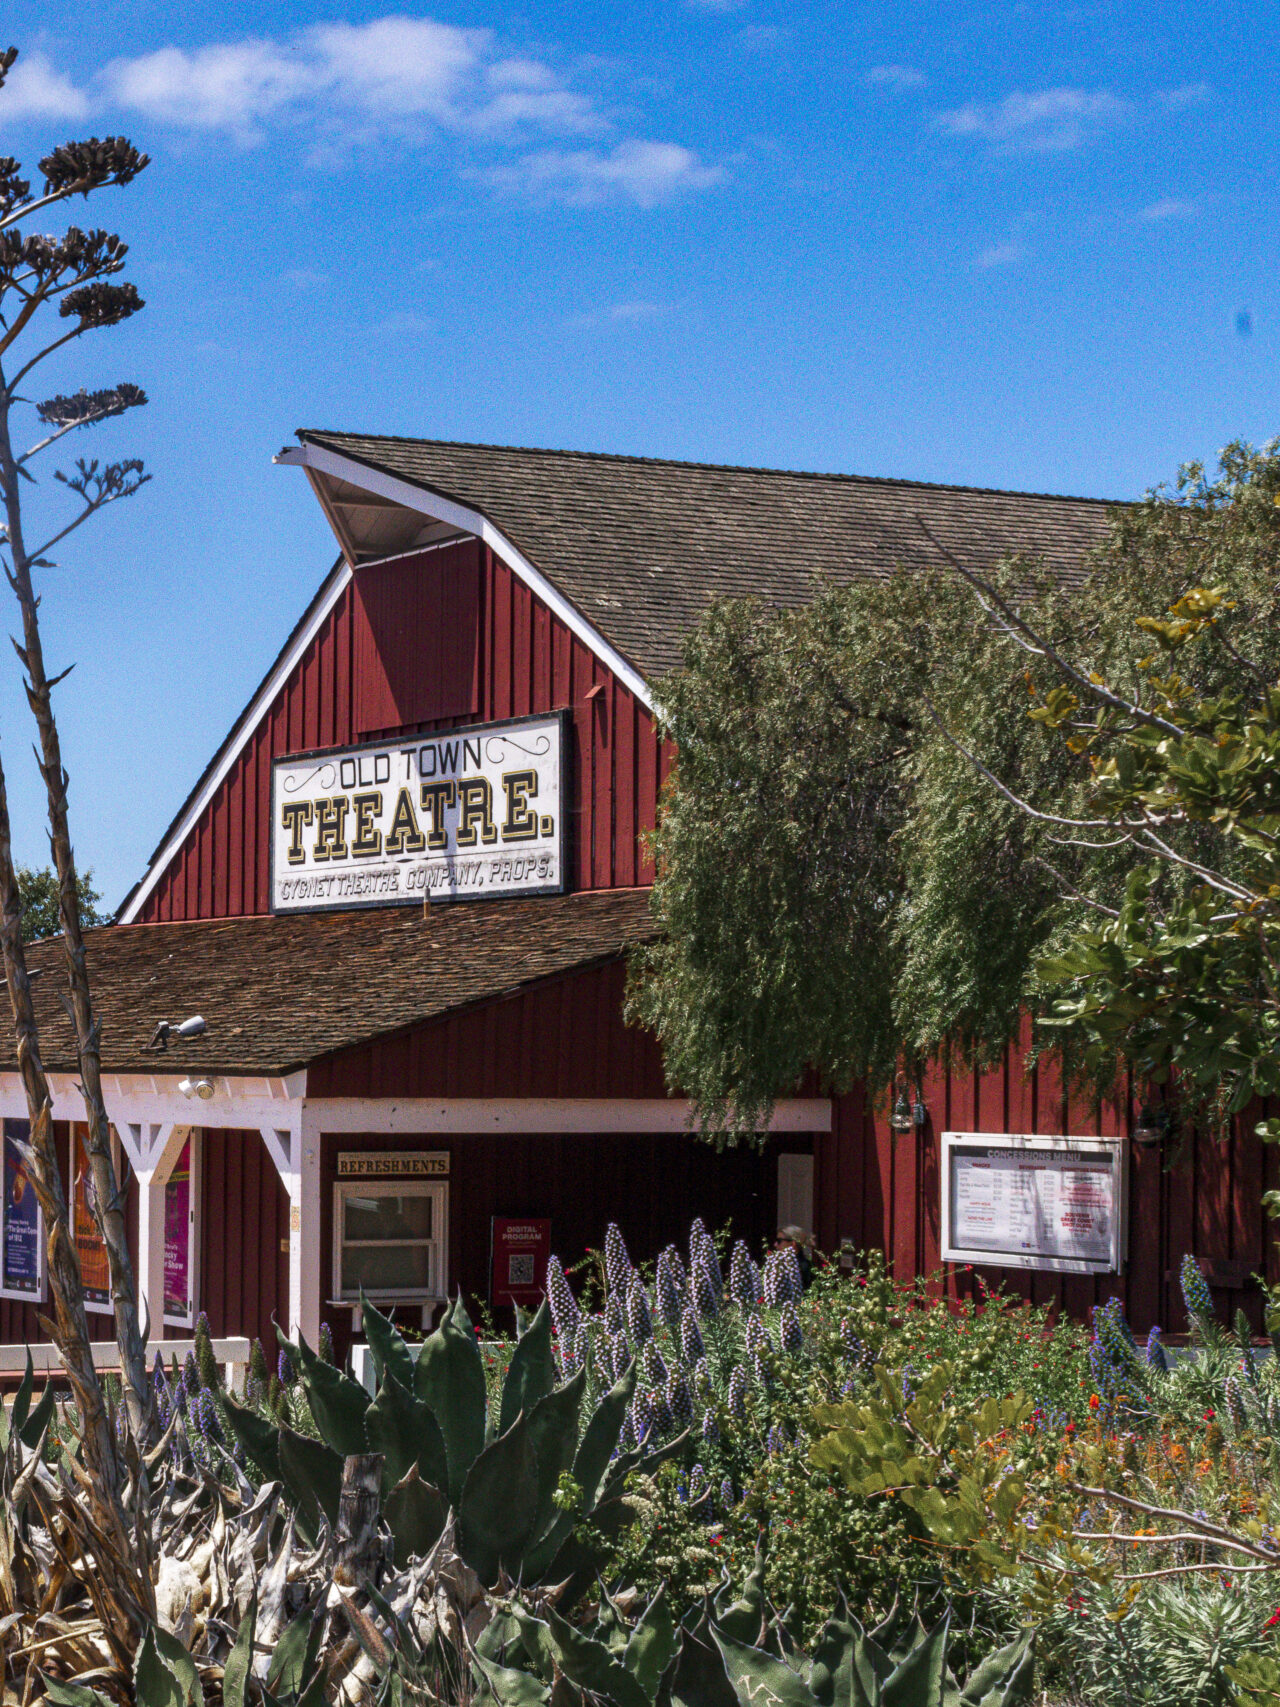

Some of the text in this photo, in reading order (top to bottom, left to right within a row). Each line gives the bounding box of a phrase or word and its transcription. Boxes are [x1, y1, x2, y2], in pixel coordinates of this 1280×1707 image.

[339, 737, 482, 790] OLD TOWN
[282, 768, 554, 866] THEATRE.
[280, 855, 554, 900] CYGNET THEATRE COMPANY, PROPS.
[987, 1150, 1081, 1162] CONCESSIONS MENU
[502, 1233, 542, 1241] PROGRAM
[506, 1225, 538, 1233] DIGITAL
